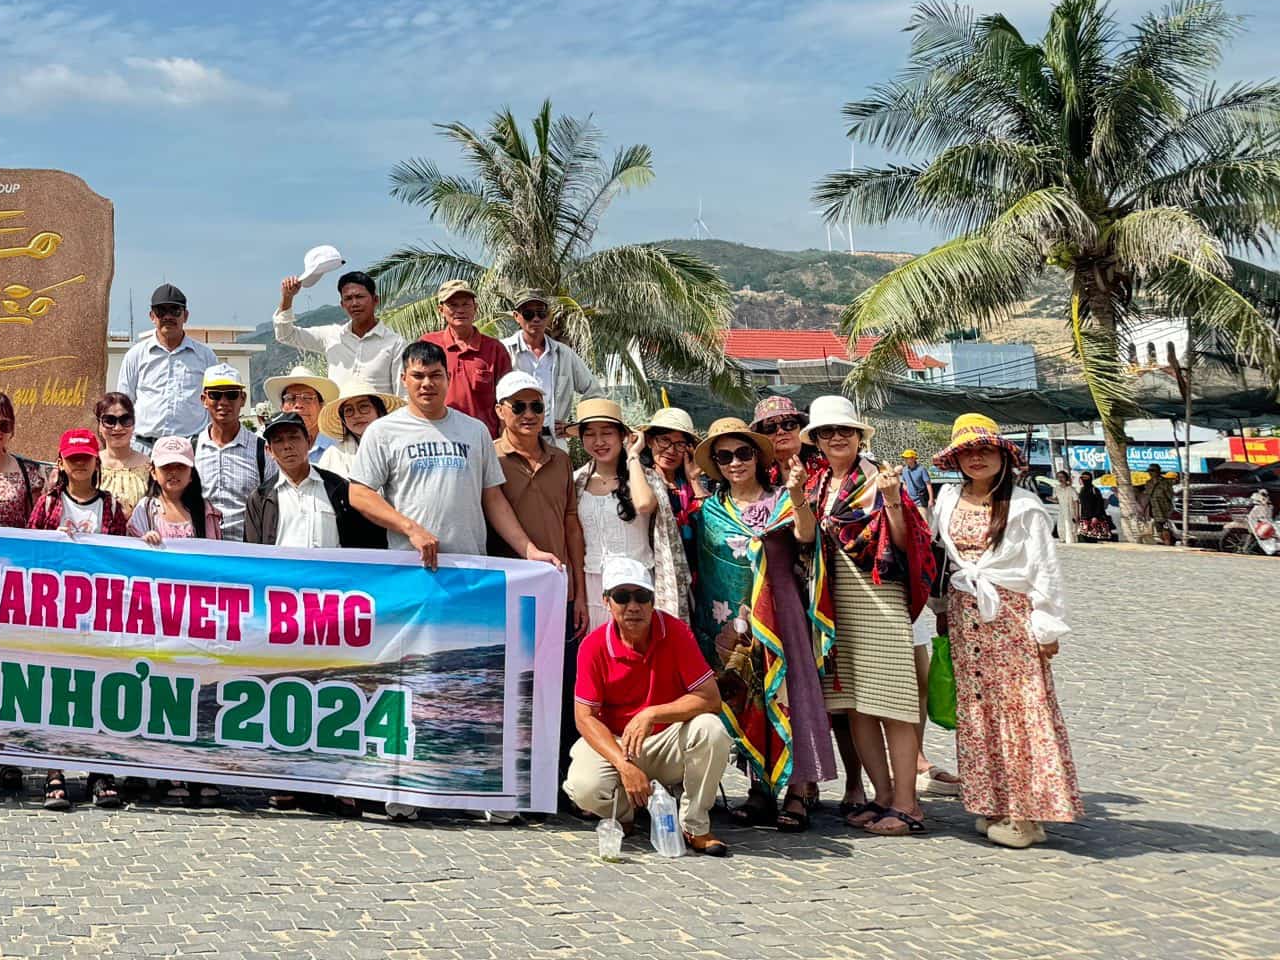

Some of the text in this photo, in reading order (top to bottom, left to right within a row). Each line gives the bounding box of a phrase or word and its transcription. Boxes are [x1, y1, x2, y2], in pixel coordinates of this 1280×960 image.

[407, 441, 470, 459] CHILLIN'
[1077, 447, 1106, 467] Tiger
[267, 590, 372, 647] BMG
[221, 680, 411, 756] 2024
